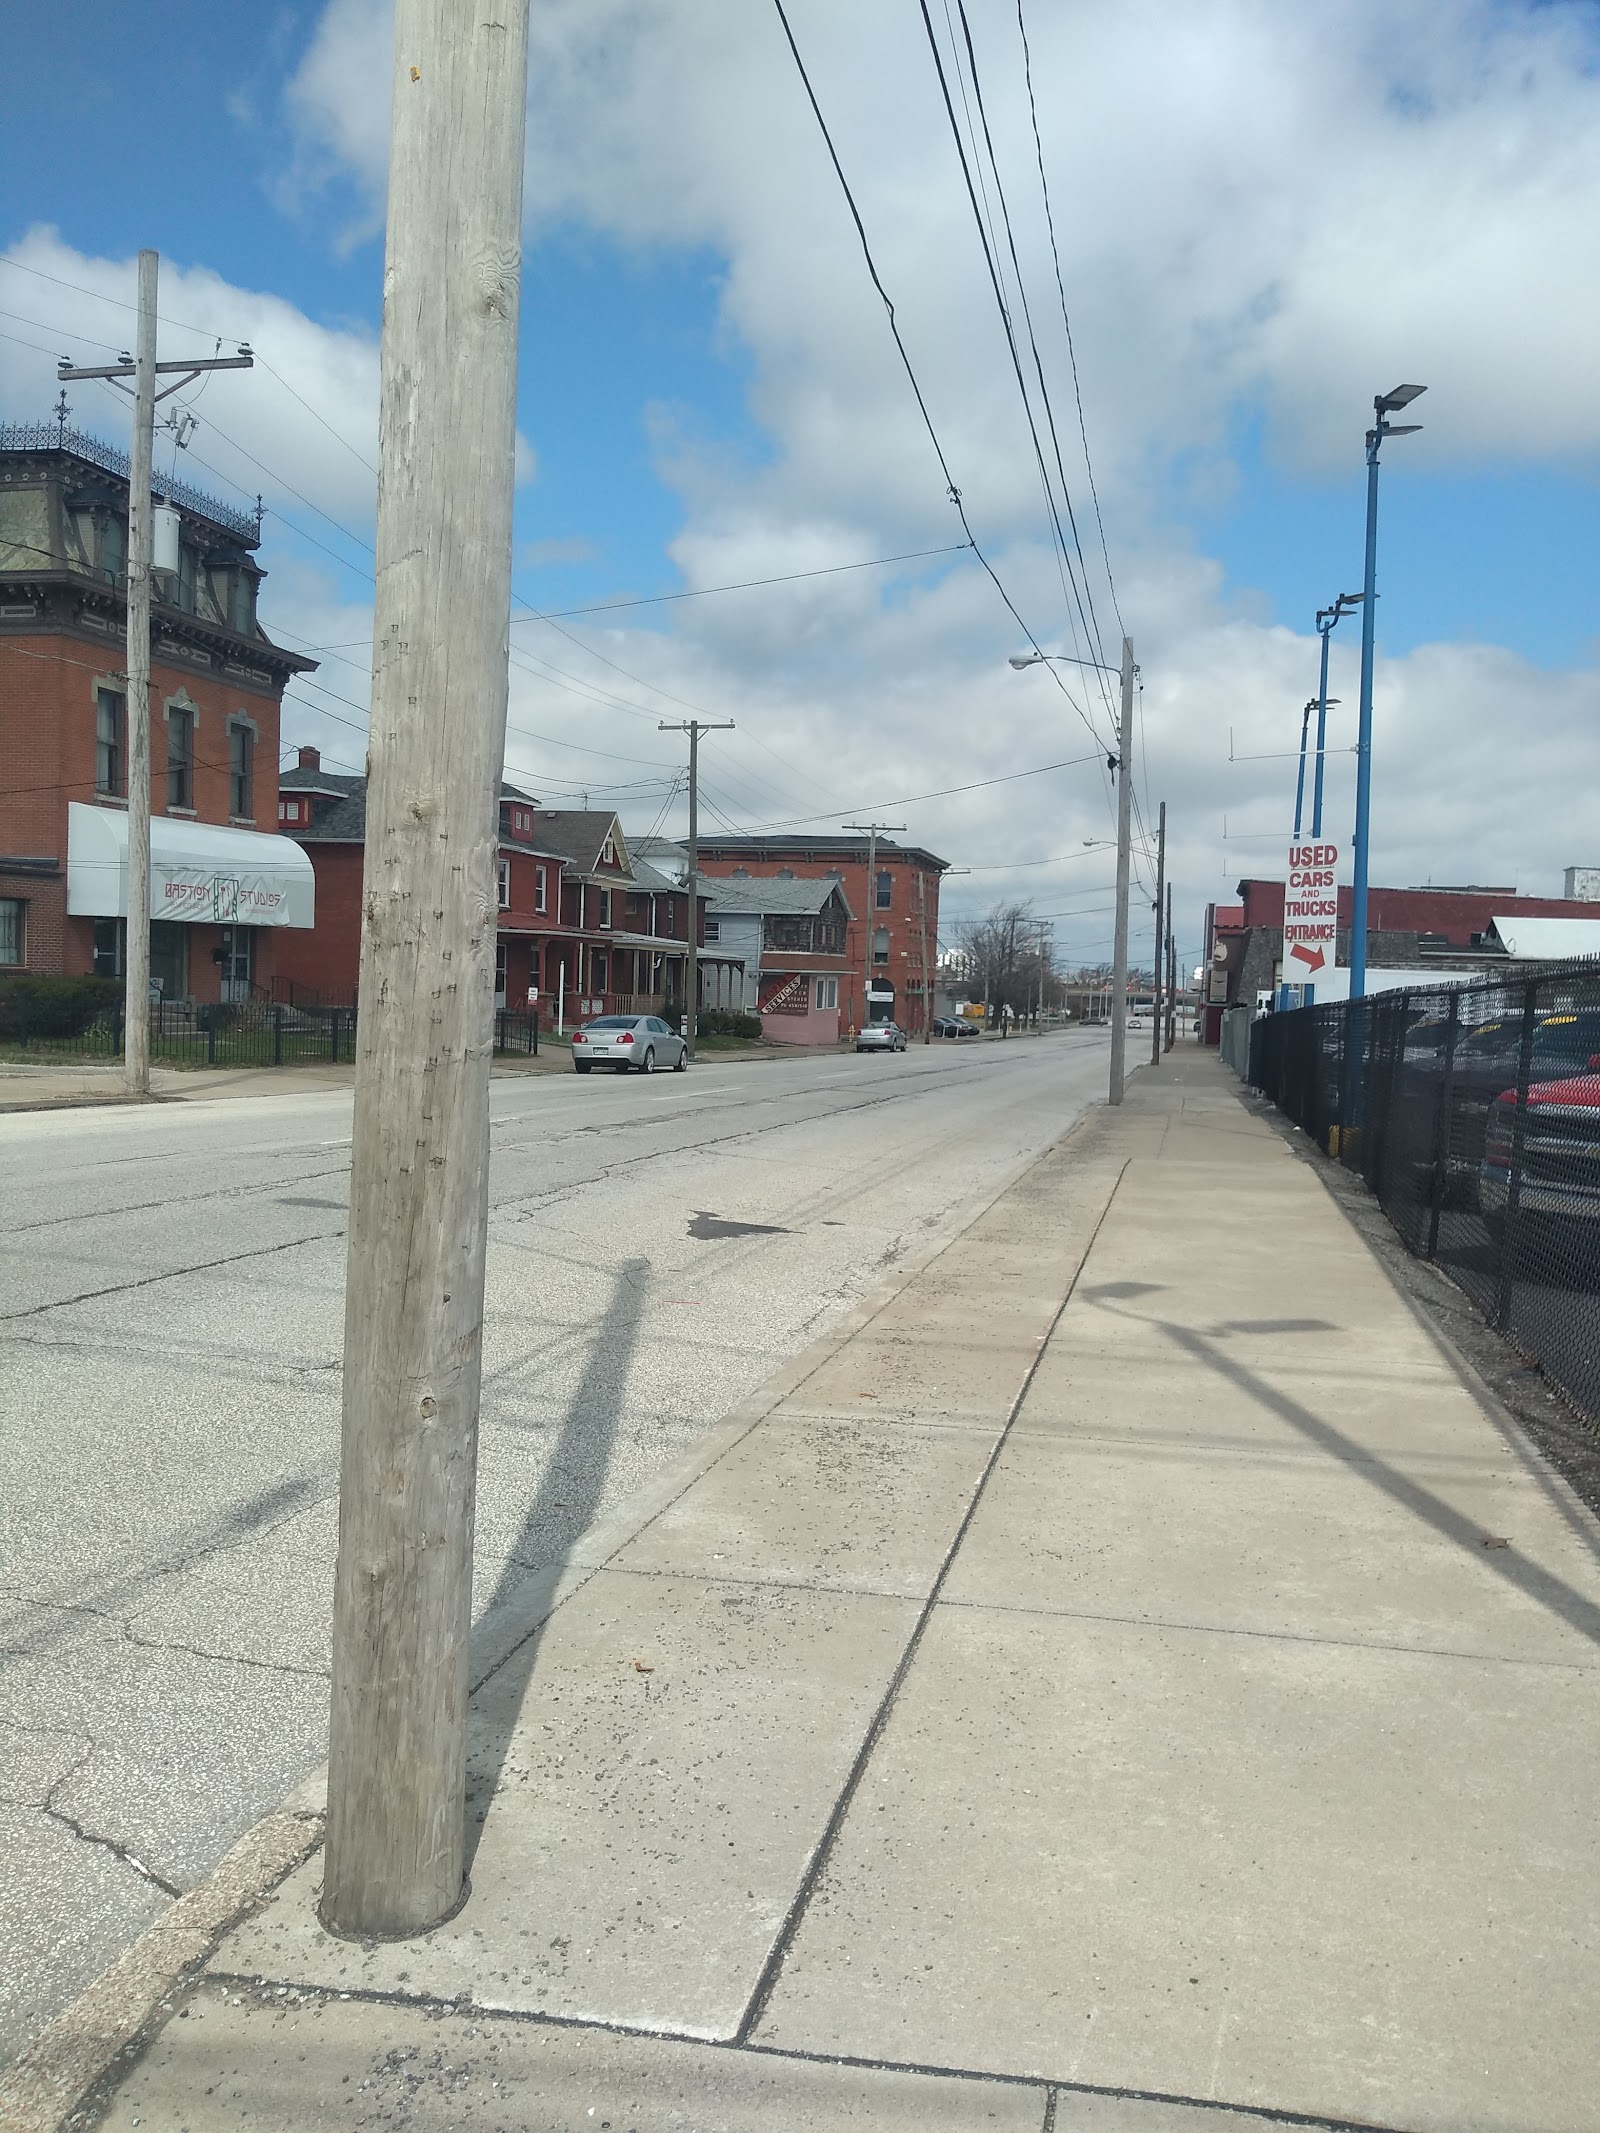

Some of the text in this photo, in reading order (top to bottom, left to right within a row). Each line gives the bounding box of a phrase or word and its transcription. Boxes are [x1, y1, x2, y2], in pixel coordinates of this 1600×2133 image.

[1289, 844, 1338, 868] USED
[1289, 870, 1335, 888] CARS
[165, 883, 282, 907] BASTION STUDIOS
[1301, 889, 1320, 898] AND
[1285, 900, 1337, 917] TRUCKS
[1284, 924, 1336, 940] ENTRANCE
[765, 979, 800, 1013] SERVICES
